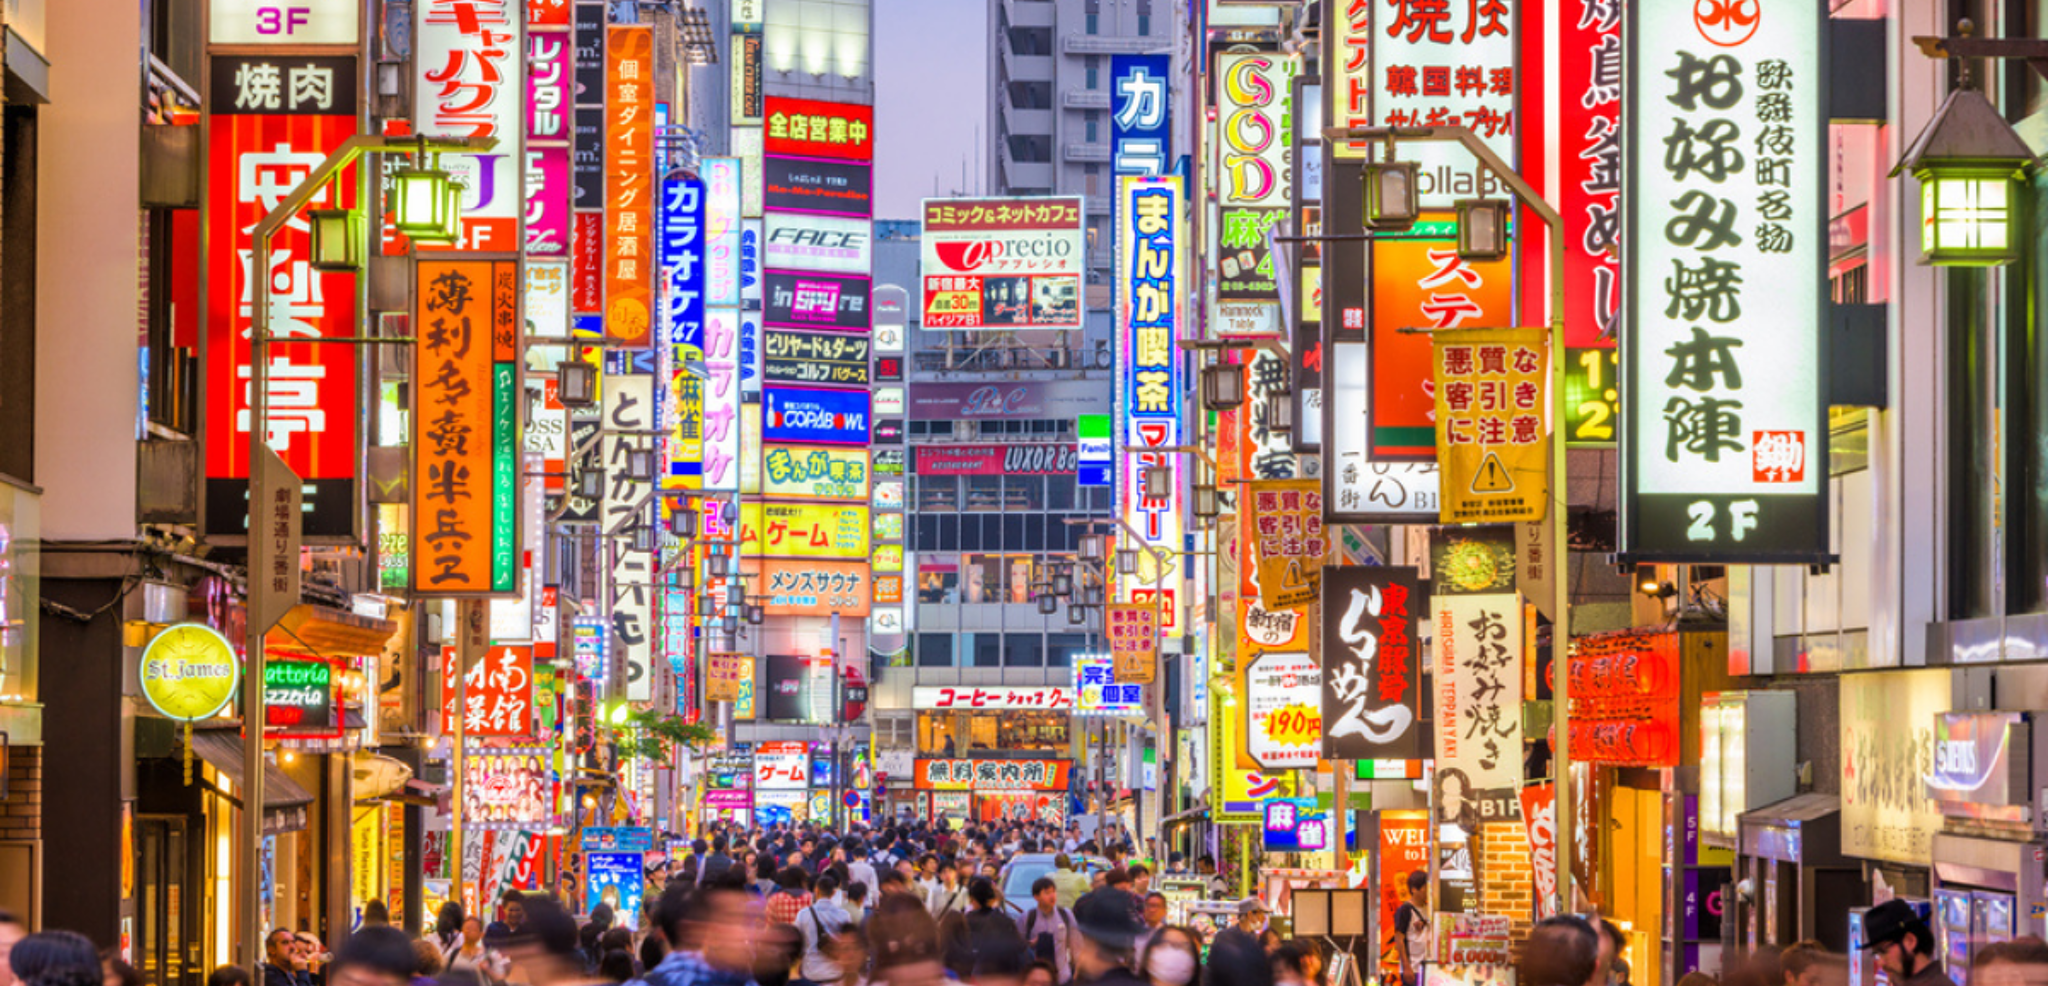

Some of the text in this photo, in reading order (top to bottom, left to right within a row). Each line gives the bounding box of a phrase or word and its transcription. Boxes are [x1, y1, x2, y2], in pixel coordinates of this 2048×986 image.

[255, 8, 310, 35] 3F
[234, 63, 335, 110] 焼肉
[534, 36, 562, 135] レンタル
[1386, 65, 1512, 97] 韓国料理
[768, 111, 868, 146] 全店営業中
[1224, 56, 1276, 203] GOD
[616, 59, 640, 281] 個室ダイニング居酒屋
[1754, 58, 1794, 255] 歌舞伎町名物
[927, 205, 1078, 225] コミック&ネットカフェ
[665, 182, 700, 316] カラオケ
[769, 227, 868, 250] FACE
[999, 259, 1067, 270] アプレシオ
[1662, 49, 1746, 465] お好み焼本陣
[237, 142, 329, 451] 安楽亭
[927, 277, 981, 291] 新宿最大
[496, 270, 515, 350] 炭火串焼
[1135, 193, 1170, 413] まんが喫茶
[927, 314, 981, 326] ハイジアB1
[765, 333, 868, 360] ビリヤード&ダーツ
[1443, 346, 1540, 376] 悪質な
[796, 362, 831, 380] ゴルフ
[831, 367, 868, 382] バグース
[680, 375, 700, 440] 麻雀
[704, 318, 736, 485] カラオケ
[1444, 380, 1539, 411] 客引き
[1445, 415, 1540, 445] に注意
[766, 450, 865, 484] まんが喫茶
[1003, 445, 1056, 473] LUXOR
[1257, 491, 1322, 512] 悪質な
[767, 520, 830, 548] ゲーム
[1258, 515, 1322, 535] 客引き
[1686, 499, 1760, 542] 2F
[273, 487, 292, 593] 劇場通り一番街
[1260, 537, 1325, 558] に注意
[769, 570, 861, 593] メンズサウナ
[1111, 609, 1151, 623] 悪質な
[1111, 624, 1151, 637] 客引き
[1249, 607, 1295, 633] 新宿
[1112, 639, 1152, 651] に注意
[446, 647, 527, 693] 湖南
[1438, 610, 1458, 759] HIROSHIMA TEPPANYAKI
[1101, 685, 1141, 703] 個室
[1462, 609, 1517, 771] お好み焼き
[465, 694, 527, 733] 菜館
[758, 764, 806, 781] ゲーム
[927, 760, 1045, 782] 無料案内所
[1480, 799, 1521, 817] B1F
[1267, 800, 1326, 850] 麻雀
